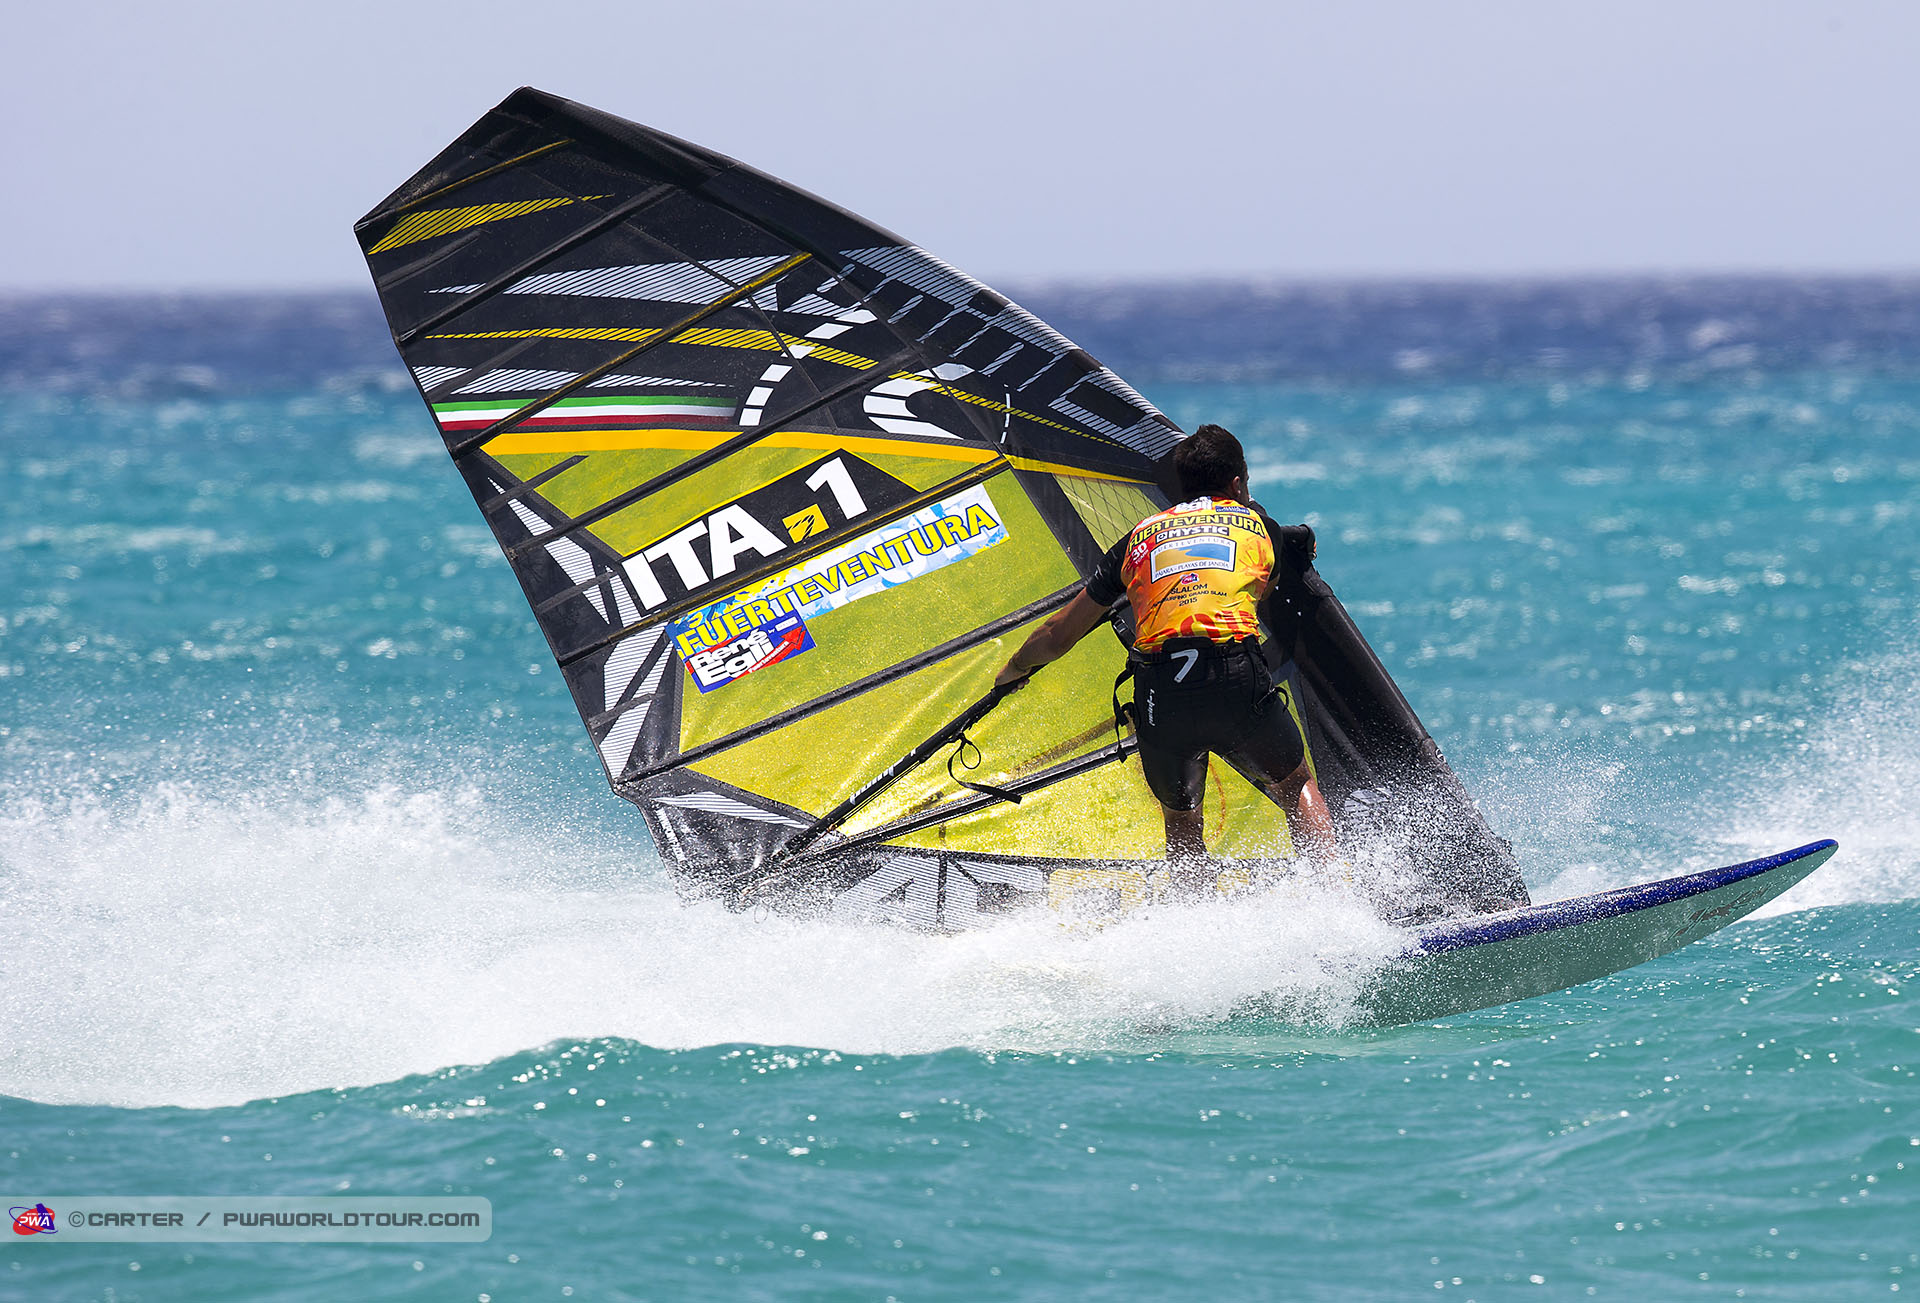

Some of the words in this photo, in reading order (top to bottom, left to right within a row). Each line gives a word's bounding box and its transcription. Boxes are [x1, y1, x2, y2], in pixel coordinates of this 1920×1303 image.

[621, 503, 788, 611] ITA
[805, 456, 869, 521] 1
[1129, 514, 1266, 553] FUERTEVENTURA
[1168, 526, 1230, 539] MYSTIC
[1131, 542, 1148, 561] 30
[1177, 561, 1199, 570] PLAYAS
[676, 502, 1001, 658] FUERTEVENTURA
[1170, 583, 1208, 595] SLALOM
[1179, 597, 1198, 607] 2015
[688, 627, 769, 668] René
[696, 640, 776, 687] Egli
